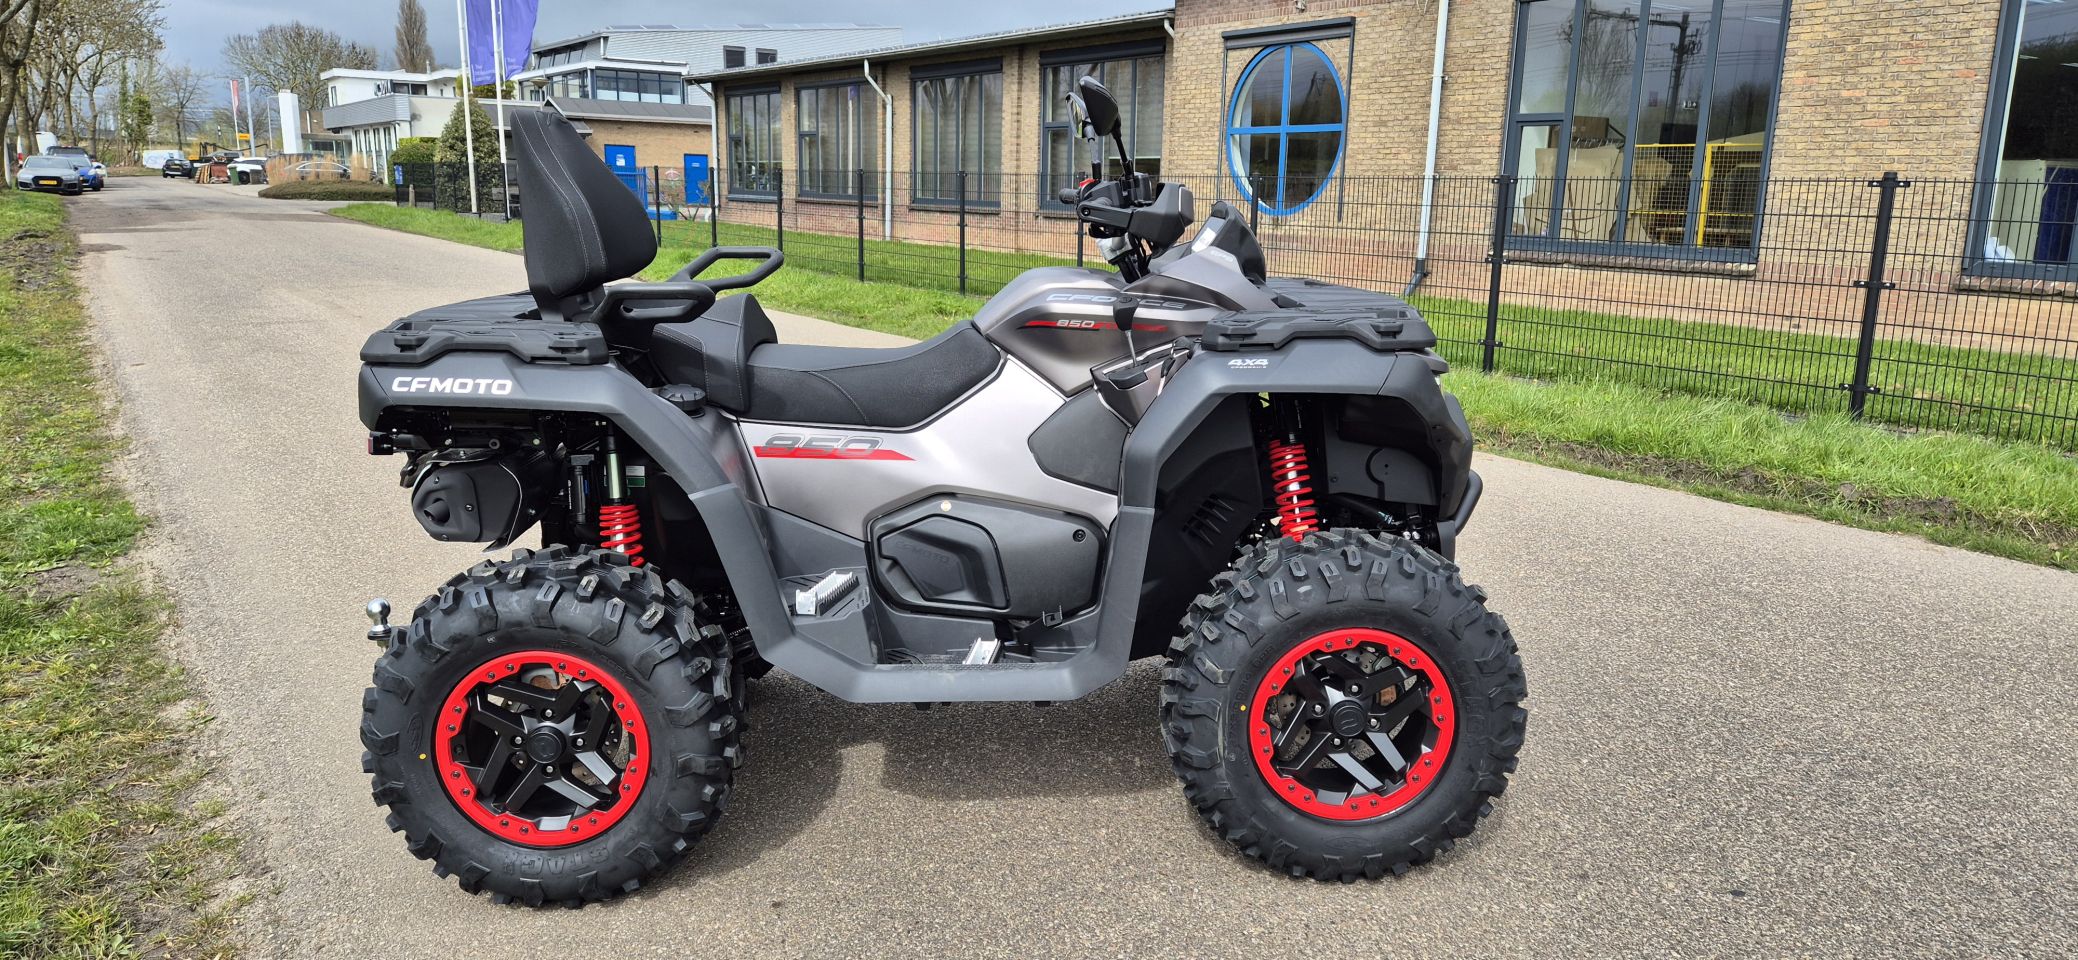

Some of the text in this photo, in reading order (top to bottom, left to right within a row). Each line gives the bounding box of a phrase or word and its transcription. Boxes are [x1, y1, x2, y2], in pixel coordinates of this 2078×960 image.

[1046, 293, 1187, 309] CFOCE
[1056, 319, 1095, 328] 850
[391, 376, 513, 395] CFMOTO
[762, 433, 882, 456] 850
